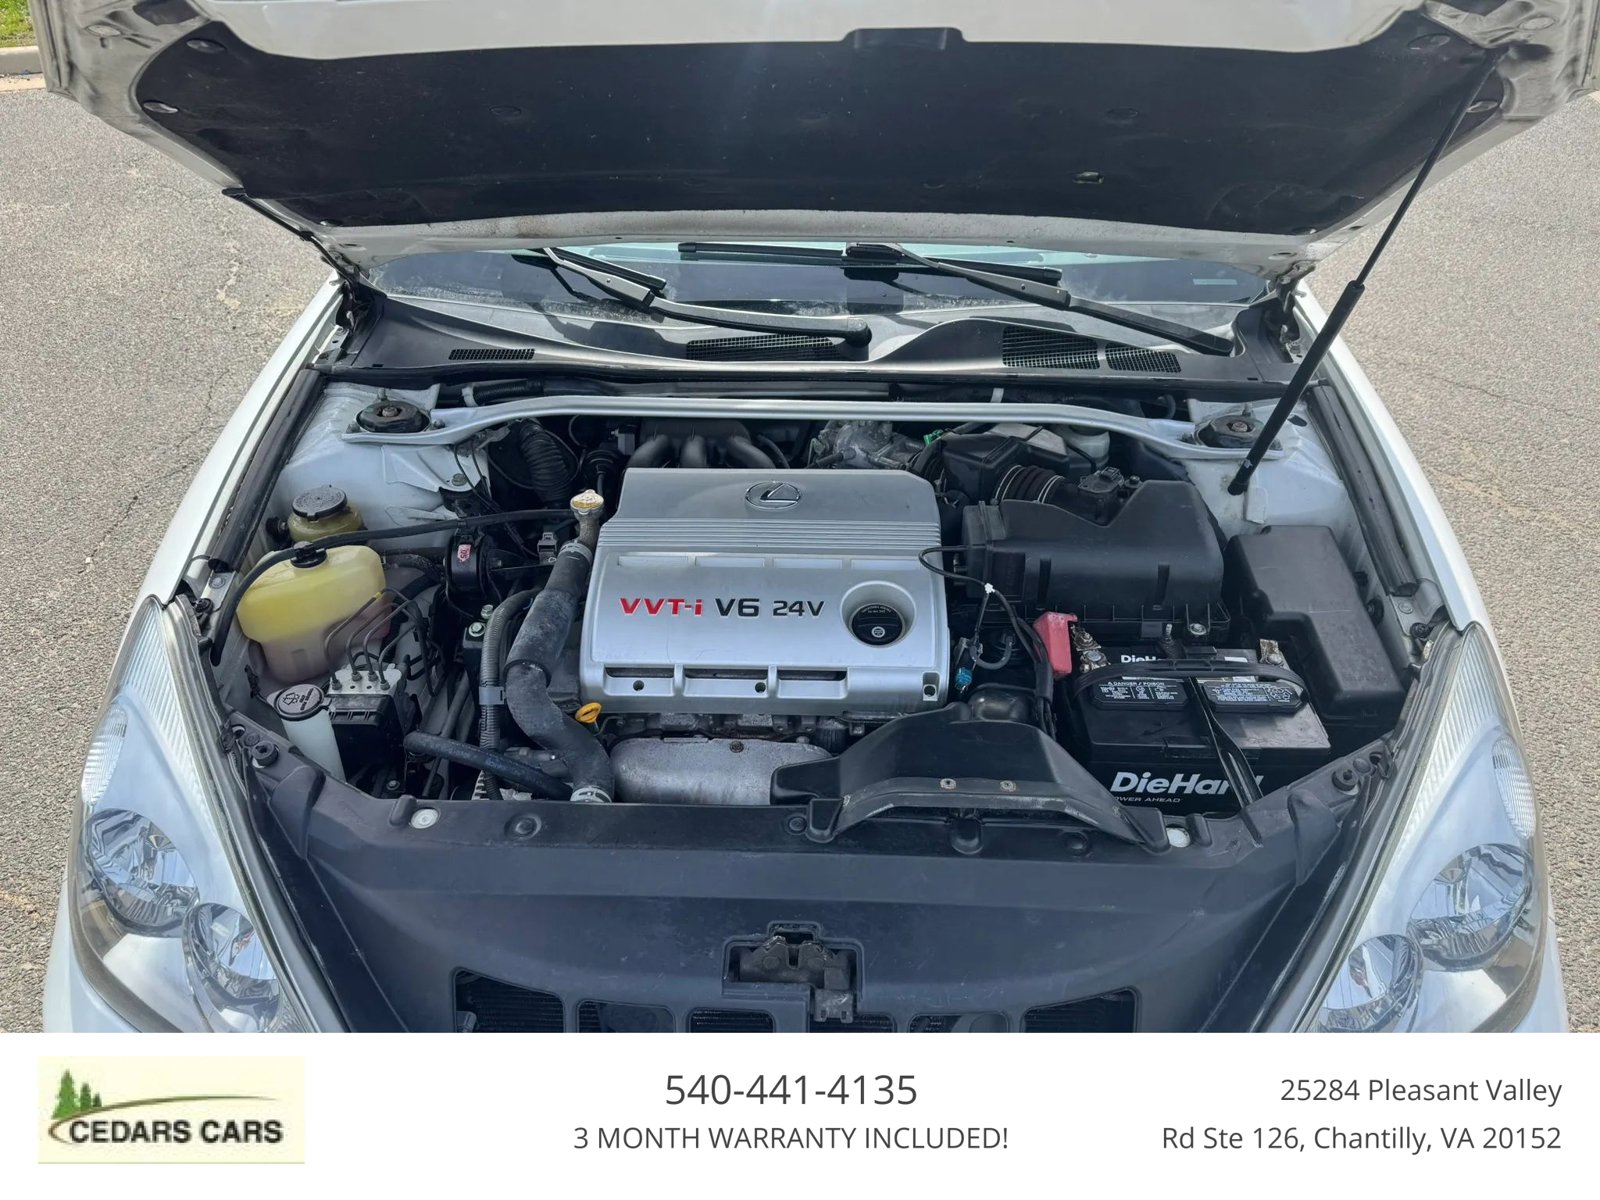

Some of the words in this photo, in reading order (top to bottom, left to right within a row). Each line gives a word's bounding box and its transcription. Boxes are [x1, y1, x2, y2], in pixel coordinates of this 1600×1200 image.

[620, 597, 704, 616] VVT-i
[715, 598, 761, 617] V6
[772, 600, 826, 617] 24V
[1110, 771, 1264, 795] DieHar
